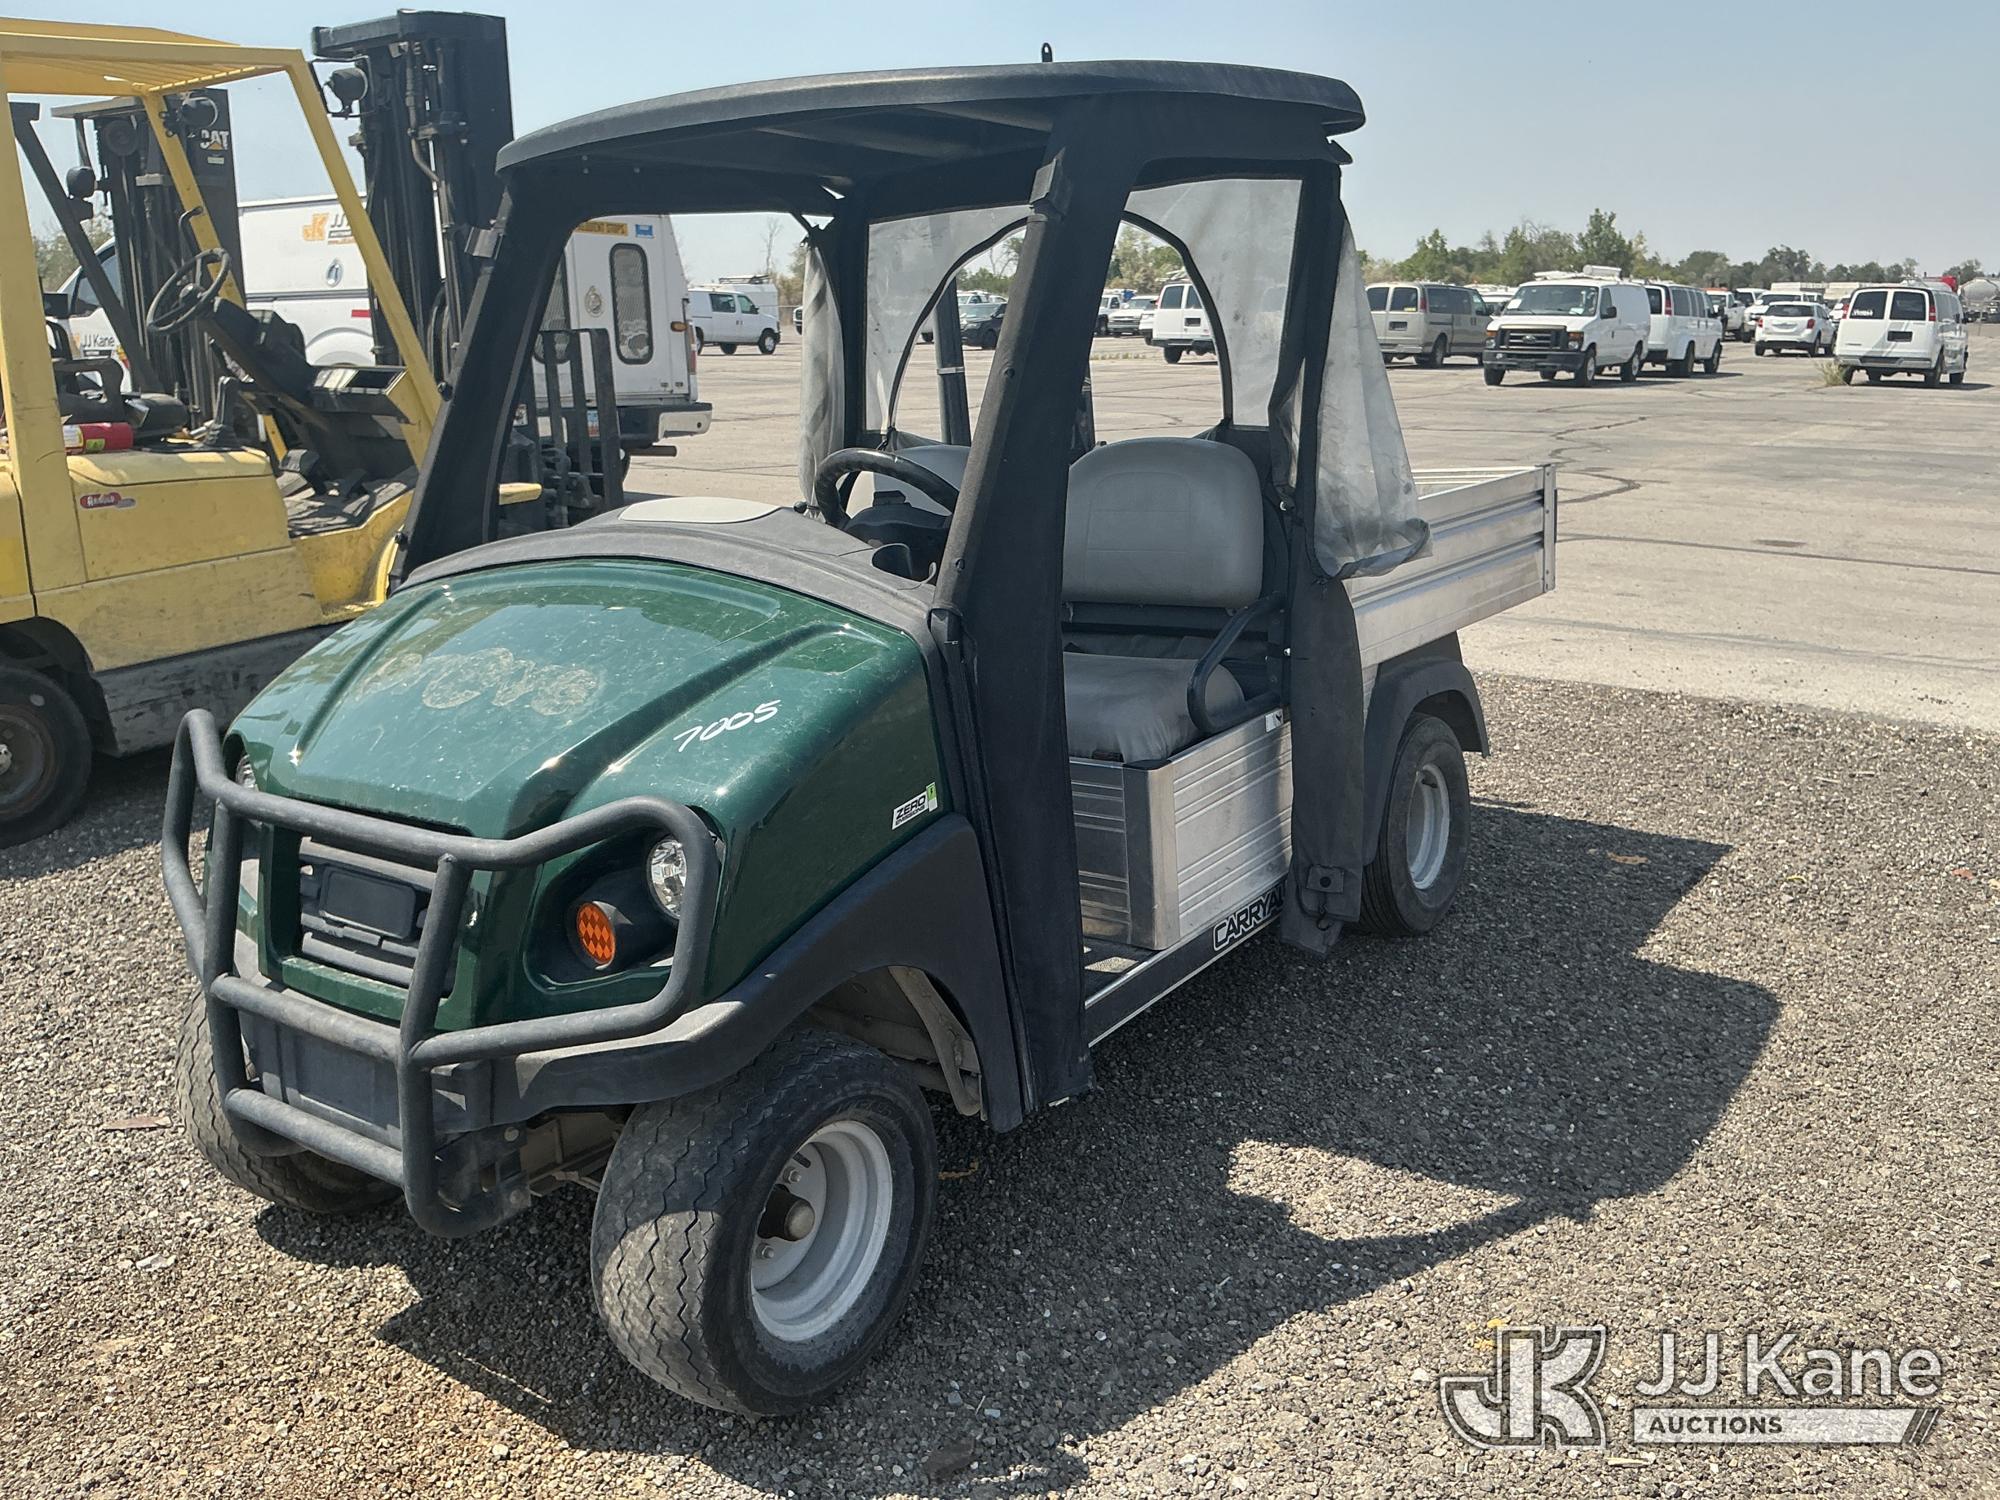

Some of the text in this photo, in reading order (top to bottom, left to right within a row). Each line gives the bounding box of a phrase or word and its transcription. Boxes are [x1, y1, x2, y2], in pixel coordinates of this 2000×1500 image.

[200, 129, 229, 150] CAT
[673, 699, 781, 752] 7005
[896, 795, 926, 819] ZERO
